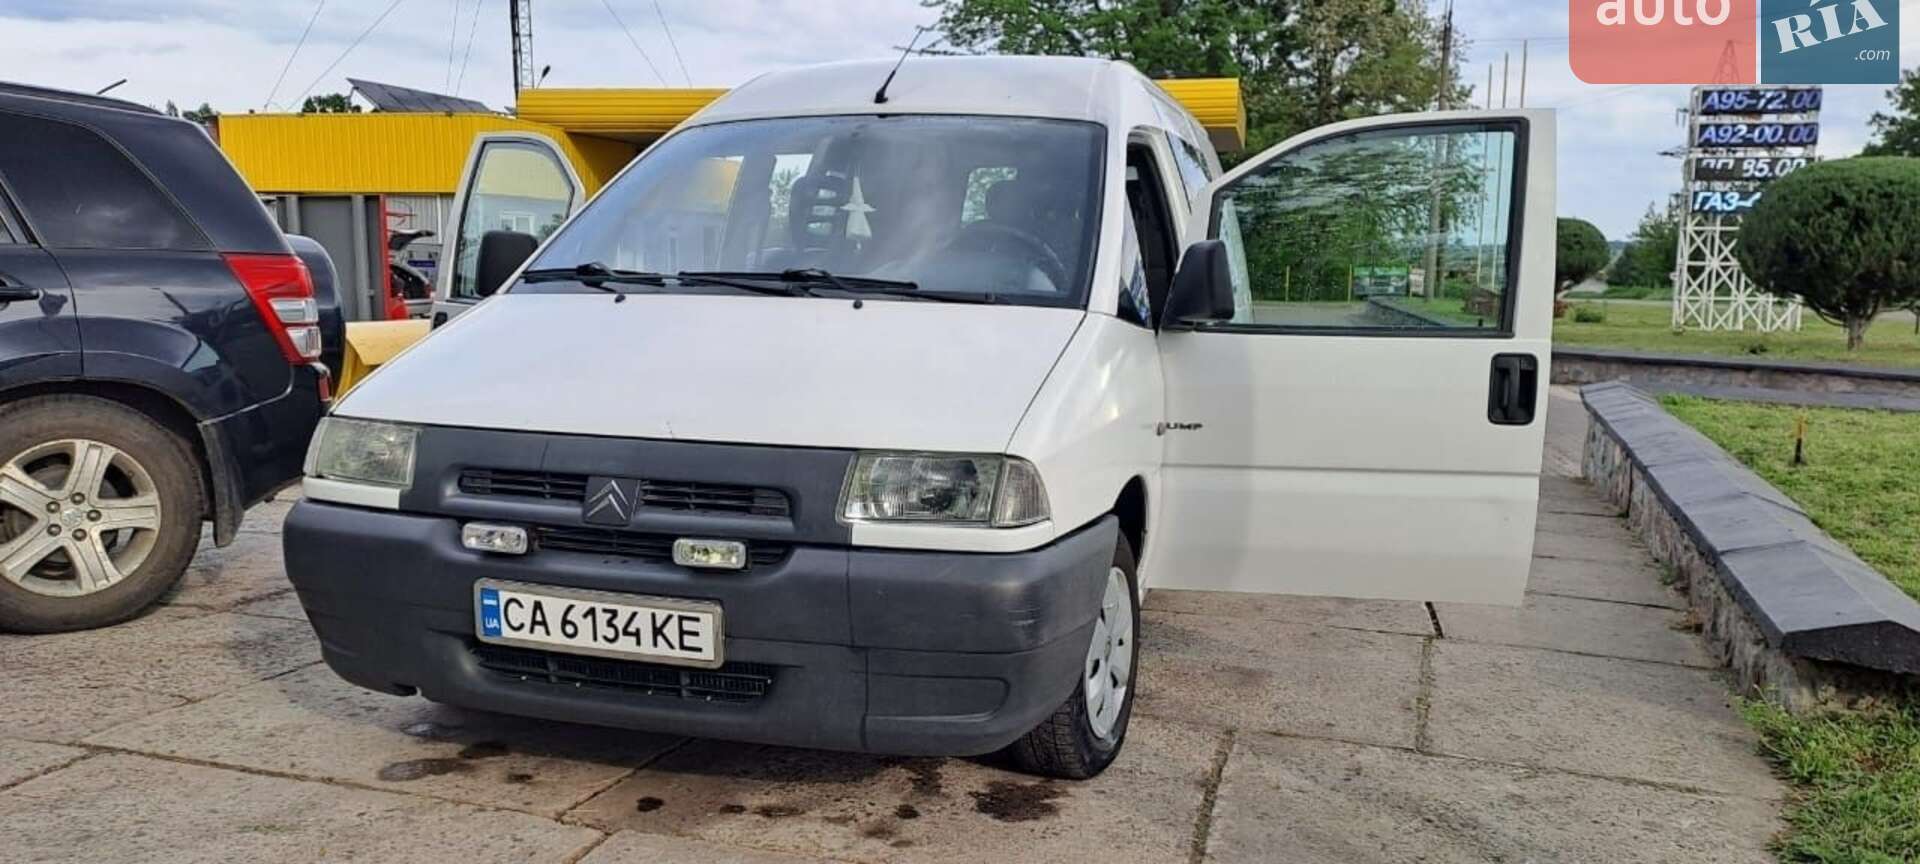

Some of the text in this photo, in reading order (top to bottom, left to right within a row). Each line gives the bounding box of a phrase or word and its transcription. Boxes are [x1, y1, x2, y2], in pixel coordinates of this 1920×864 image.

[503, 597, 703, 652] CA 6134 KE
